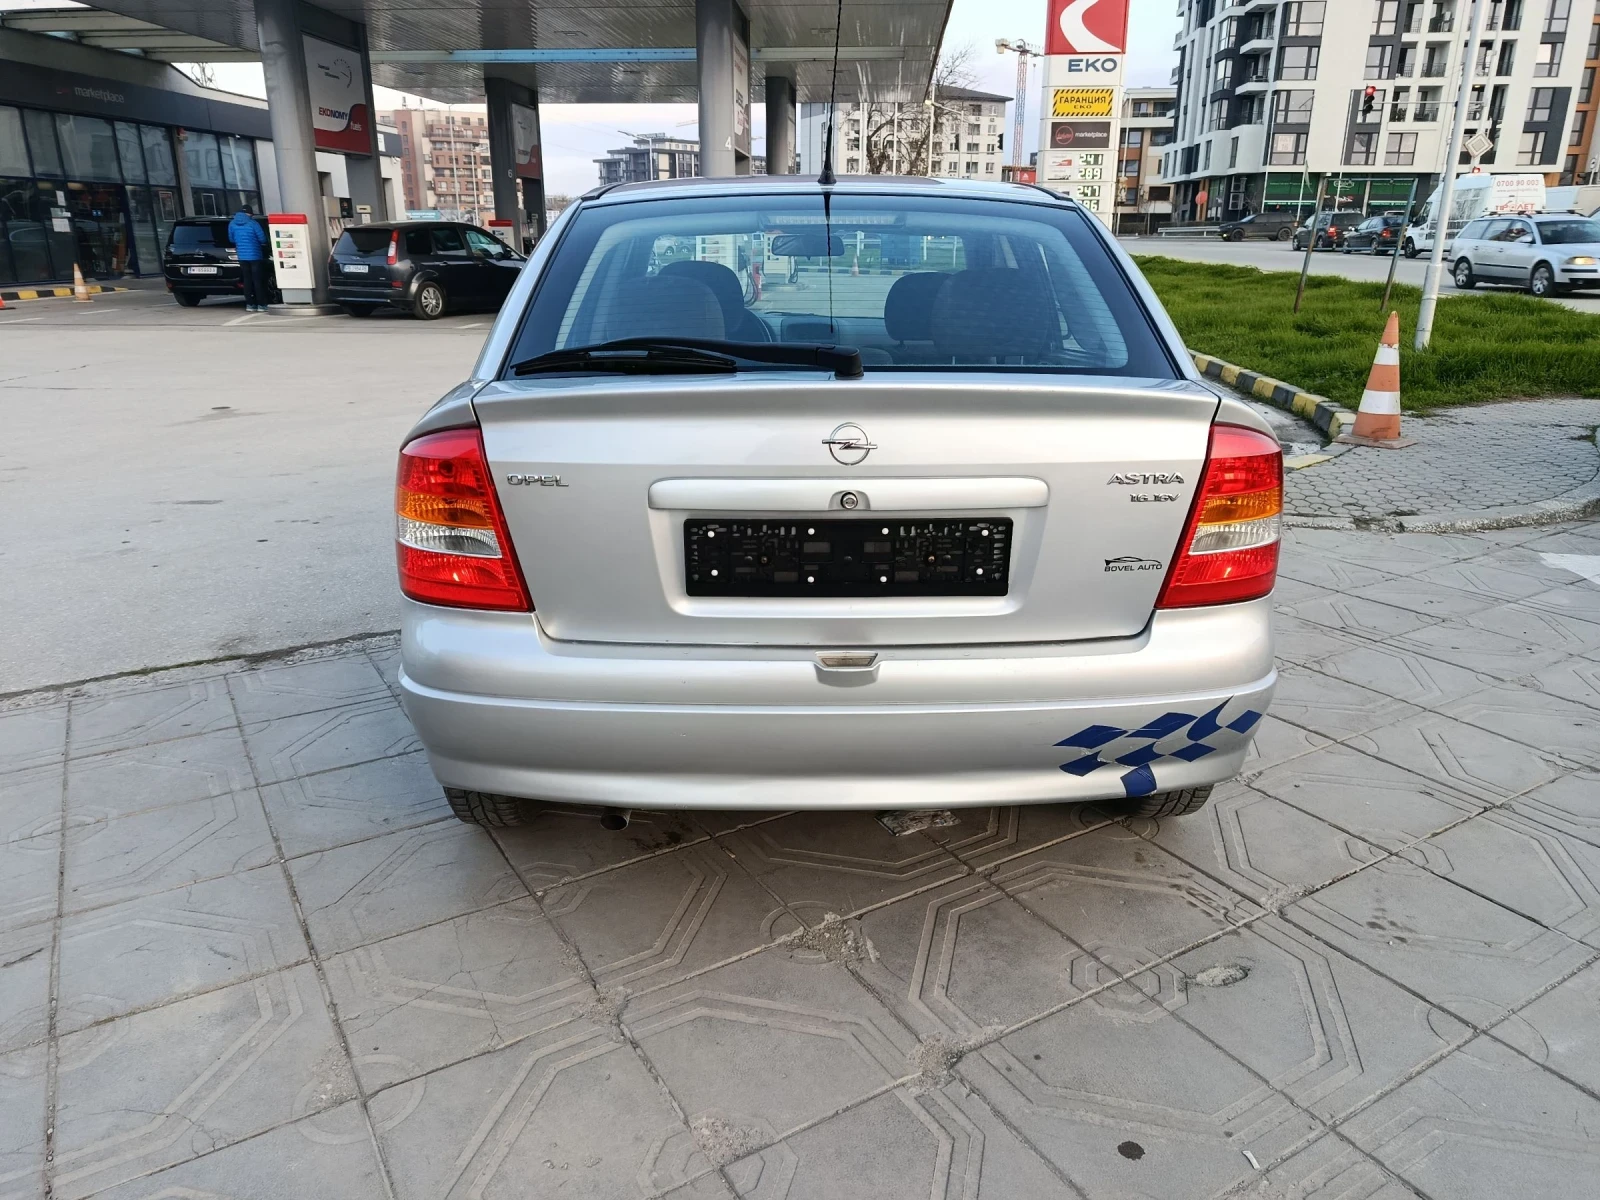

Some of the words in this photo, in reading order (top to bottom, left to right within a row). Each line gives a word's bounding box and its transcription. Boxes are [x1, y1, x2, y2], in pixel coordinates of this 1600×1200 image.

[1068, 58, 1118, 73] EKO
[74, 87, 125, 103] marketplace
[1058, 96, 1107, 105] ГАРАНЦИЯ
[318, 106, 348, 121] EKONOMY
[1075, 131, 1108, 139] marketplace
[725, 136, 732, 151] 4
[1079, 154, 1103, 165] 241
[507, 169, 513, 178] 6
[1077, 168, 1101, 180] 289
[1077, 185, 1100, 197] 247
[506, 473, 570, 488] OPEL
[1106, 472, 1185, 485] ASTRA
[1151, 493, 1181, 502] 16V
[1104, 564, 1135, 572] BOVEL
[1137, 563, 1163, 571] AUTO
